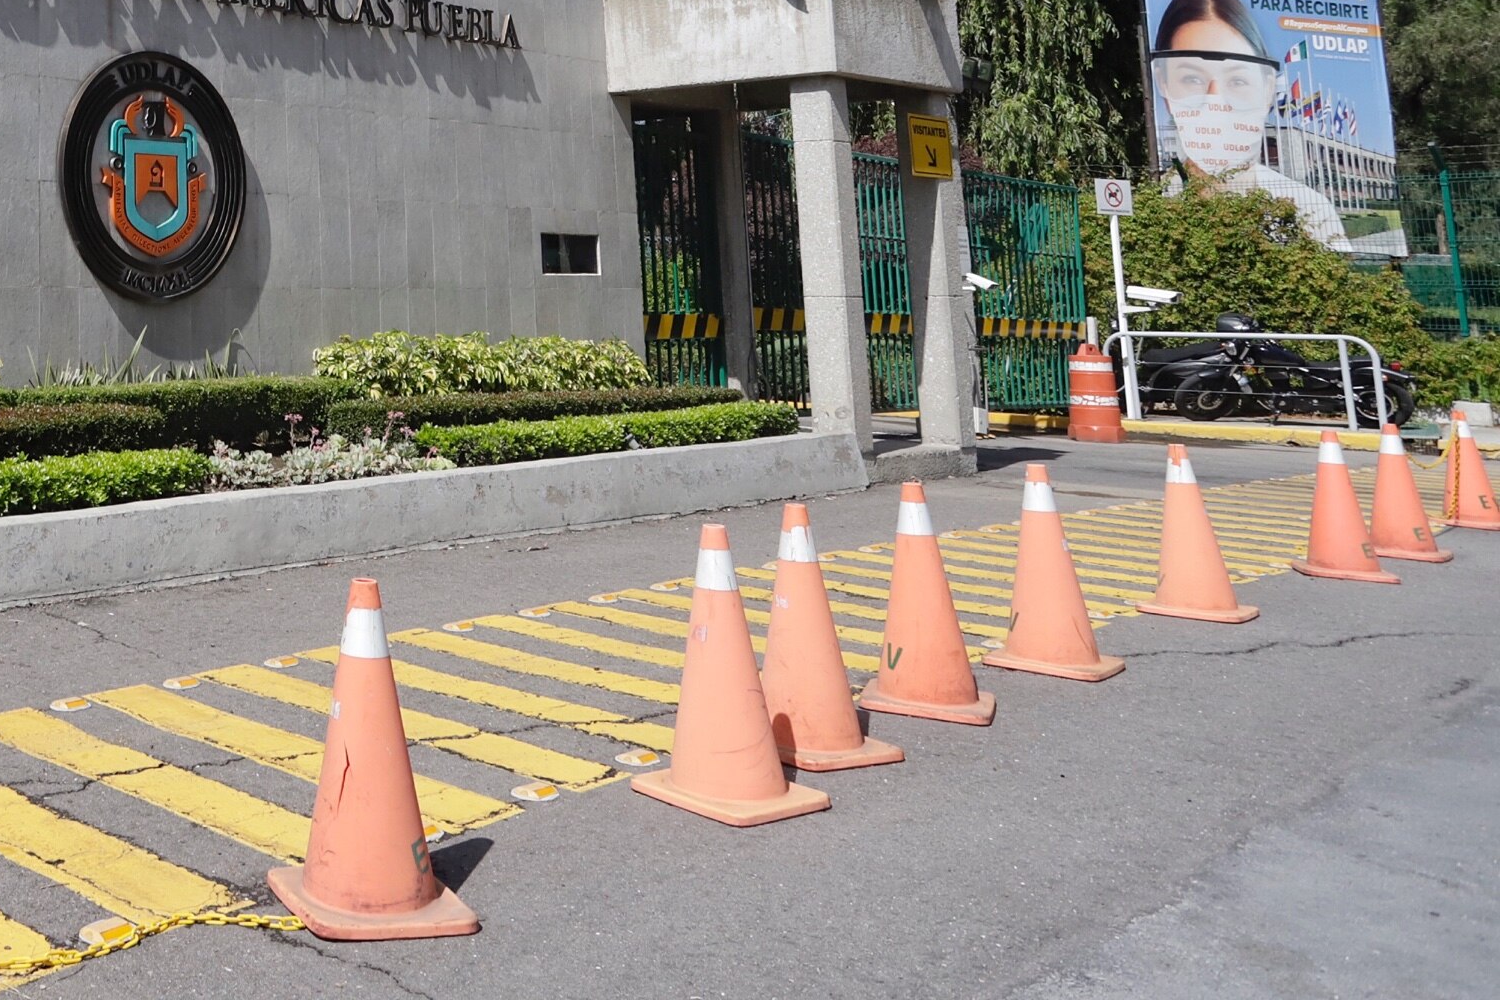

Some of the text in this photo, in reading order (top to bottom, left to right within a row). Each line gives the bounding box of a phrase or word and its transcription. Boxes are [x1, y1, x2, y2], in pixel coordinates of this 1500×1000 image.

[1295, 0, 1369, 20] RECIBIRTE
[1312, 34, 1368, 54] UDLAP
[912, 124, 947, 138] VISITANTES
[887, 642, 903, 670] V
